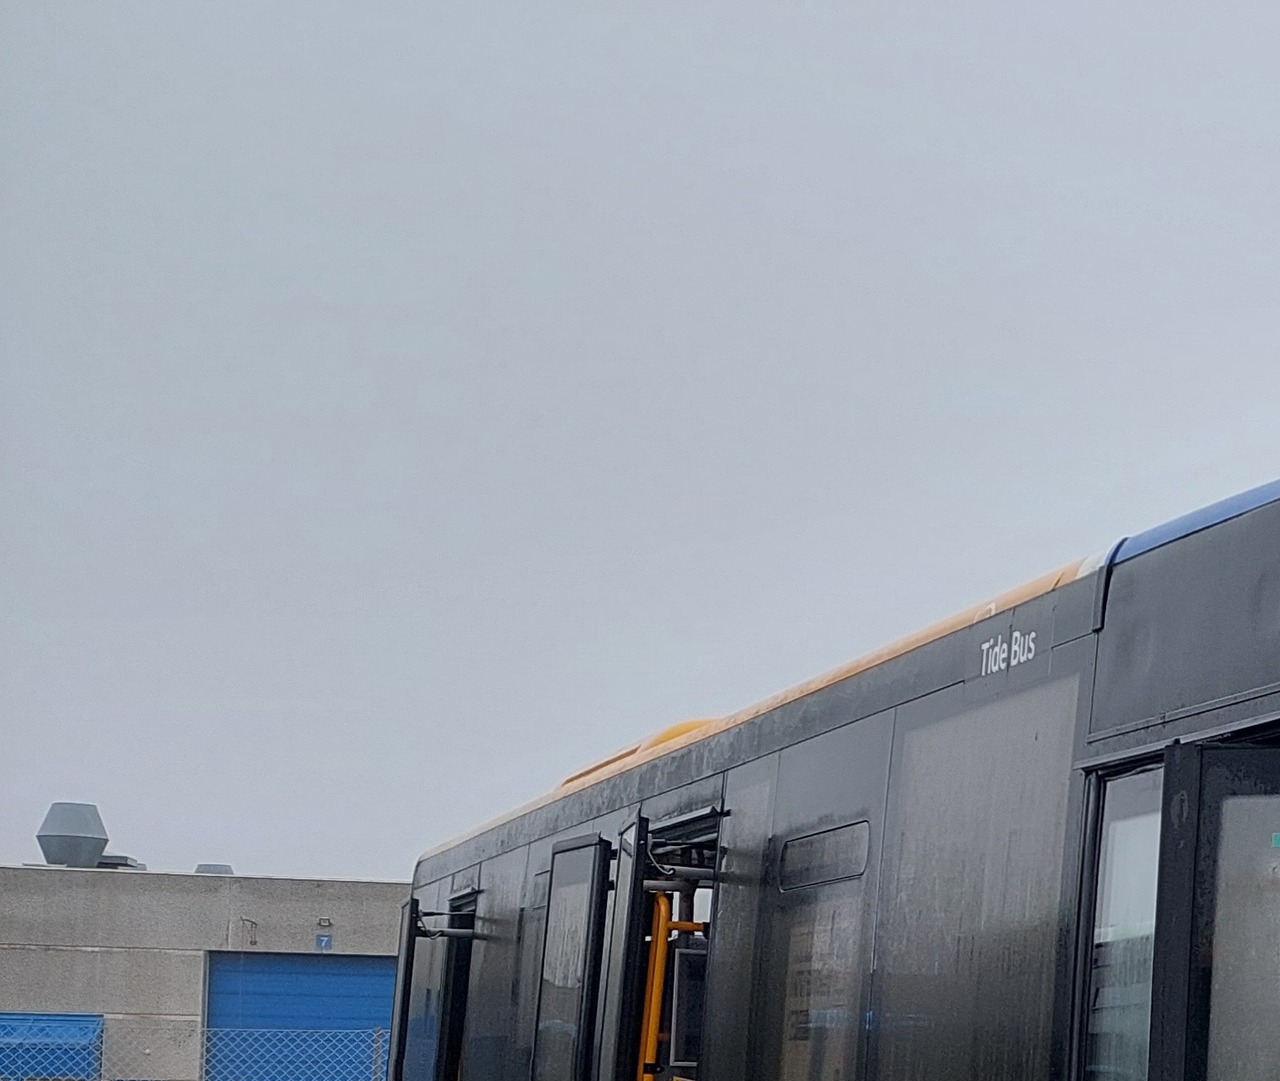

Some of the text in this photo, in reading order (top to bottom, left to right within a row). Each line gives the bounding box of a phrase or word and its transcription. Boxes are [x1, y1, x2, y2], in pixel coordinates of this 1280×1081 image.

[981, 631, 1036, 676] Tide Bus
[320, 937, 329, 947] 7
